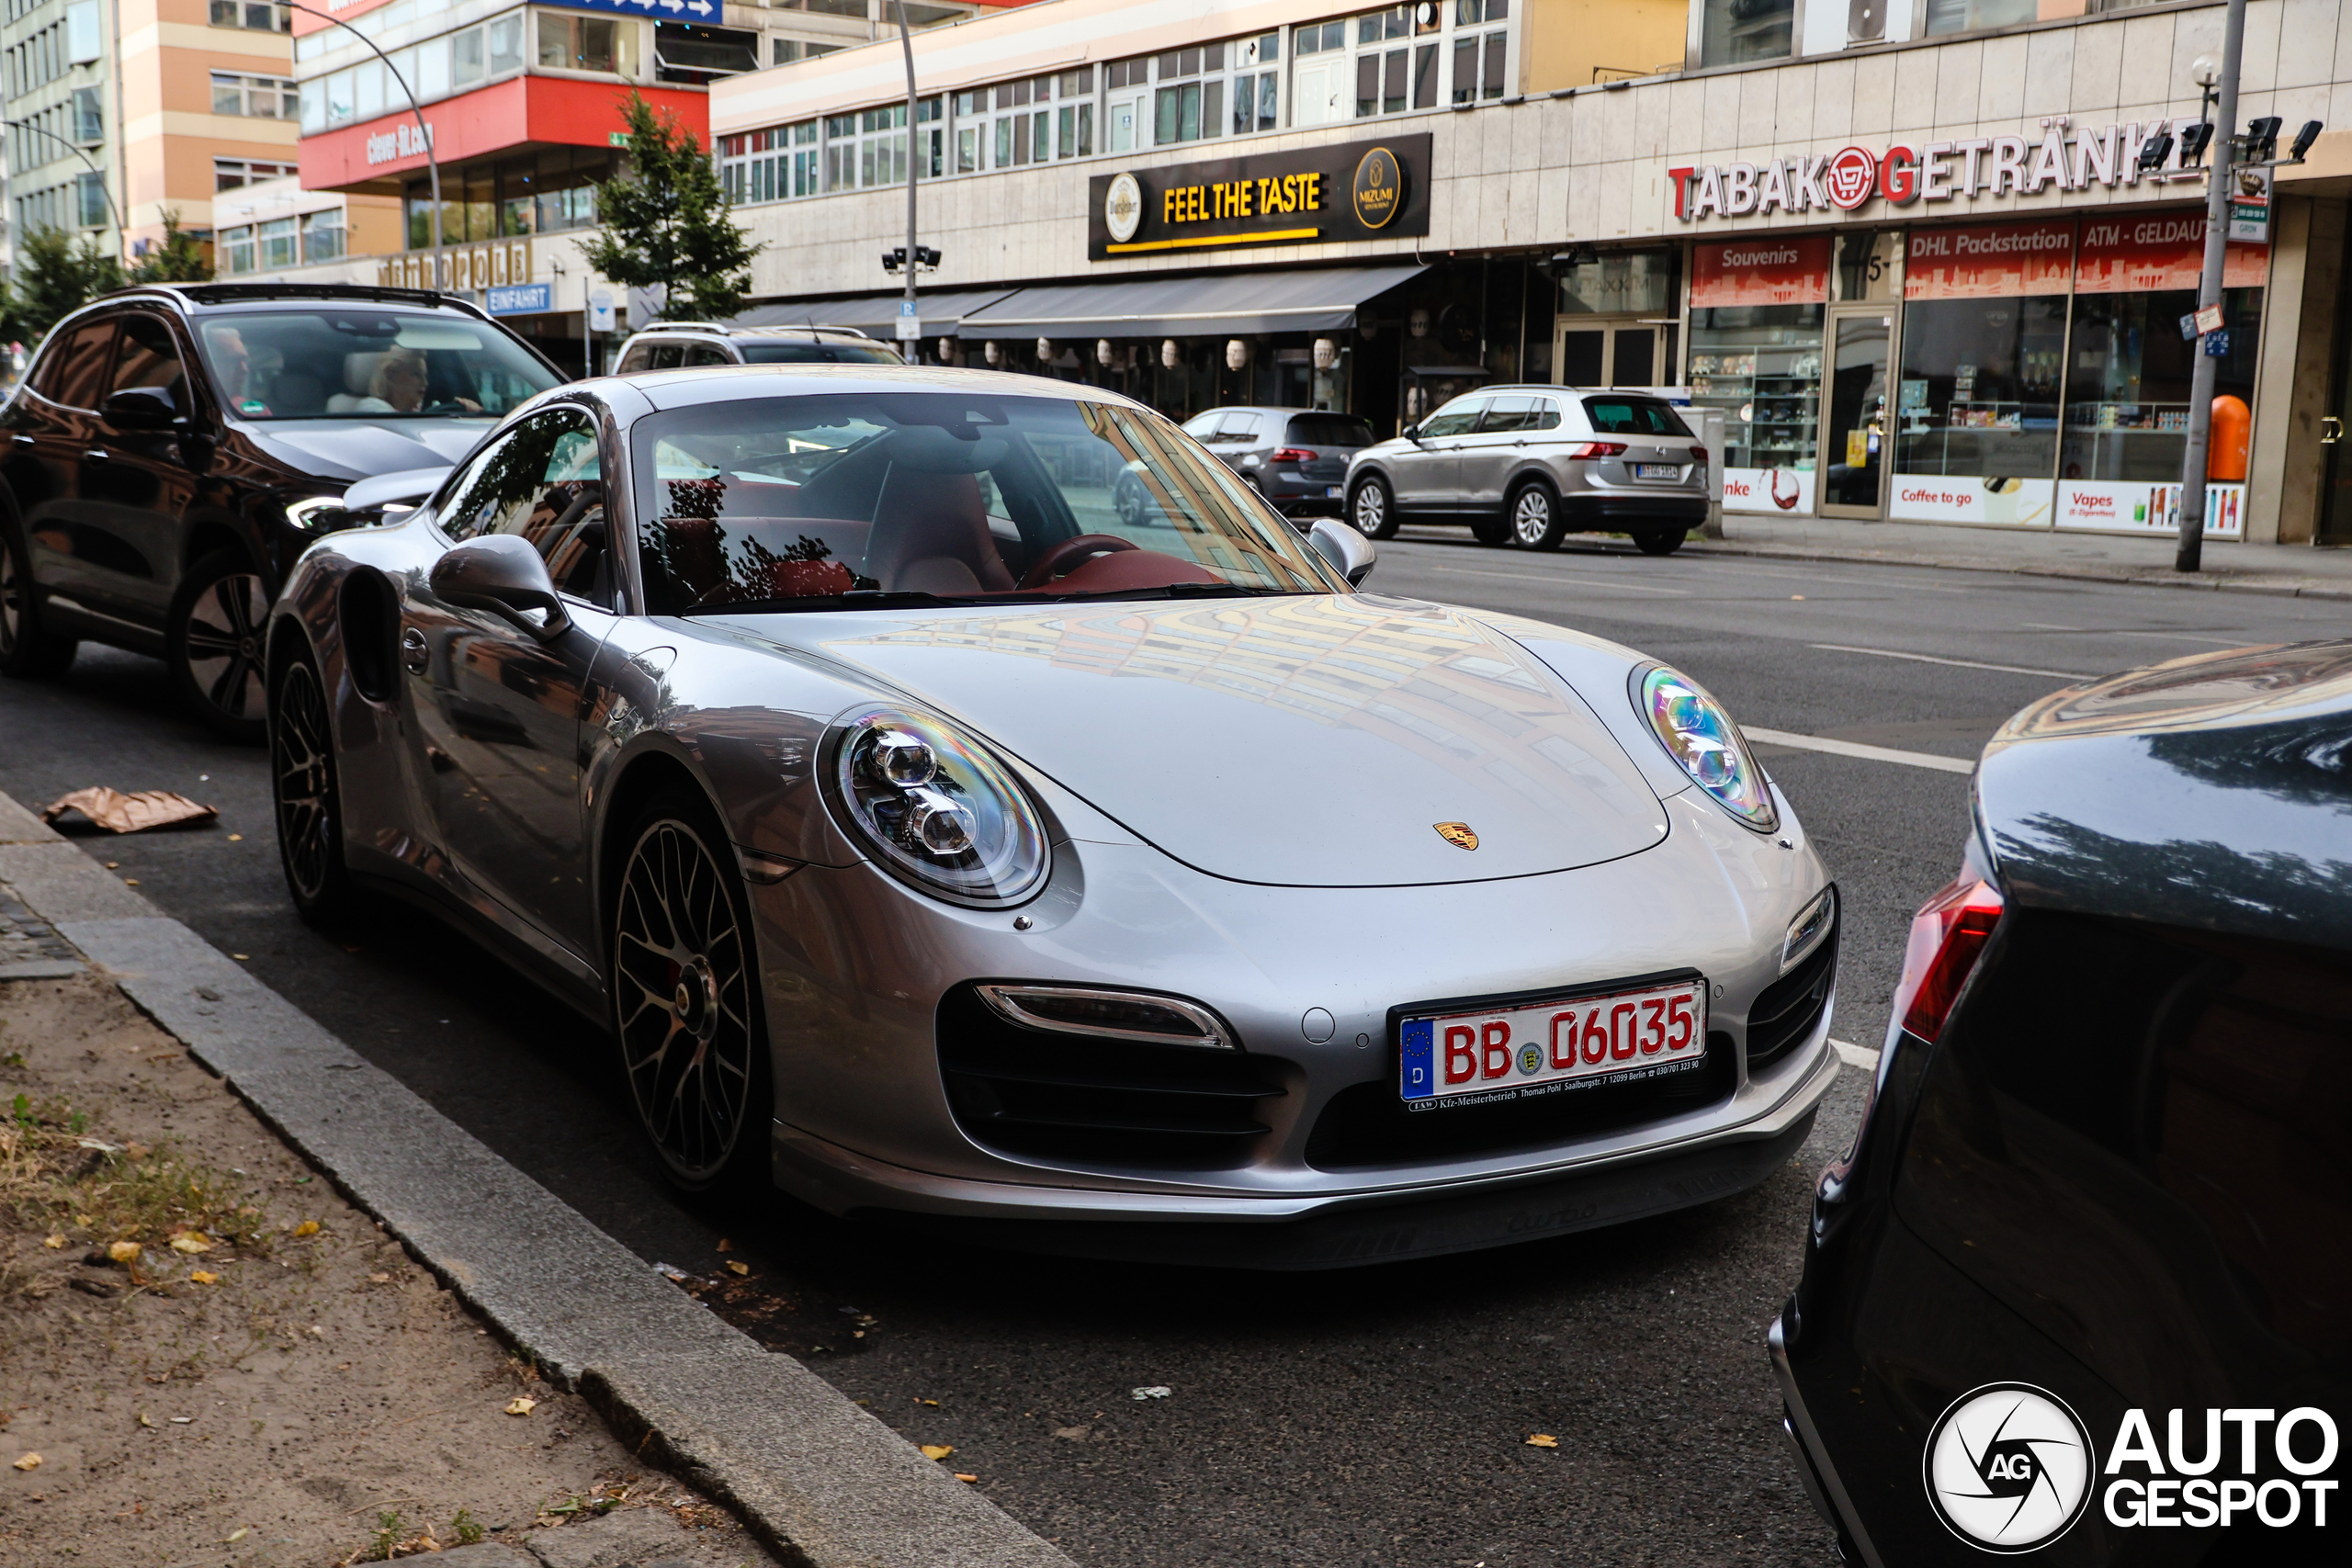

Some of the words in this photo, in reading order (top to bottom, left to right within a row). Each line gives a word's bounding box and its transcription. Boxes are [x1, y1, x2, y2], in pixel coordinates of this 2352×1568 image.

[1360, 187, 1393, 203] MIZUMI
[1668, 153, 1828, 220] TABAK
[1164, 186, 1210, 223] FEEL
[1213, 180, 1252, 220] THE
[1258, 173, 1320, 215] TASTE
[1911, 235, 1951, 257] DHL
[1955, 229, 2069, 255] Packstation
[2085, 225, 2119, 247] ATM
[1722, 245, 1798, 267] Souvenirs
[378, 247, 524, 288] METROPOLE
[490, 288, 547, 311] EINFAHRT
[1724, 479, 1750, 497] nke
[1901, 489, 1939, 504] Coffee
[1940, 492, 1954, 504] to
[1956, 493, 1973, 508] go
[2073, 491, 2113, 509] Vapes
[1444, 1020, 1513, 1086] BB
[1549, 992, 1694, 1071] 06035
[1412, 1066, 1424, 1084] D
[1440, 1090, 1517, 1109] Kfz-Meisterbetrieb
[1521, 1088, 1546, 1098] Thomas
[1547, 1083, 1562, 1094] Pohl
[1564, 1078, 1601, 1091] Saalburgstr.
[1602, 1077, 1607, 1085] 7
[1610, 1073, 1628, 1084] 12099
[1629, 1070, 1646, 1081] Berlin
[1656, 1065, 1679, 1076] 030/701
[1679, 1062, 1691, 1072] 323
[1690, 1059, 1700, 1069] 90
